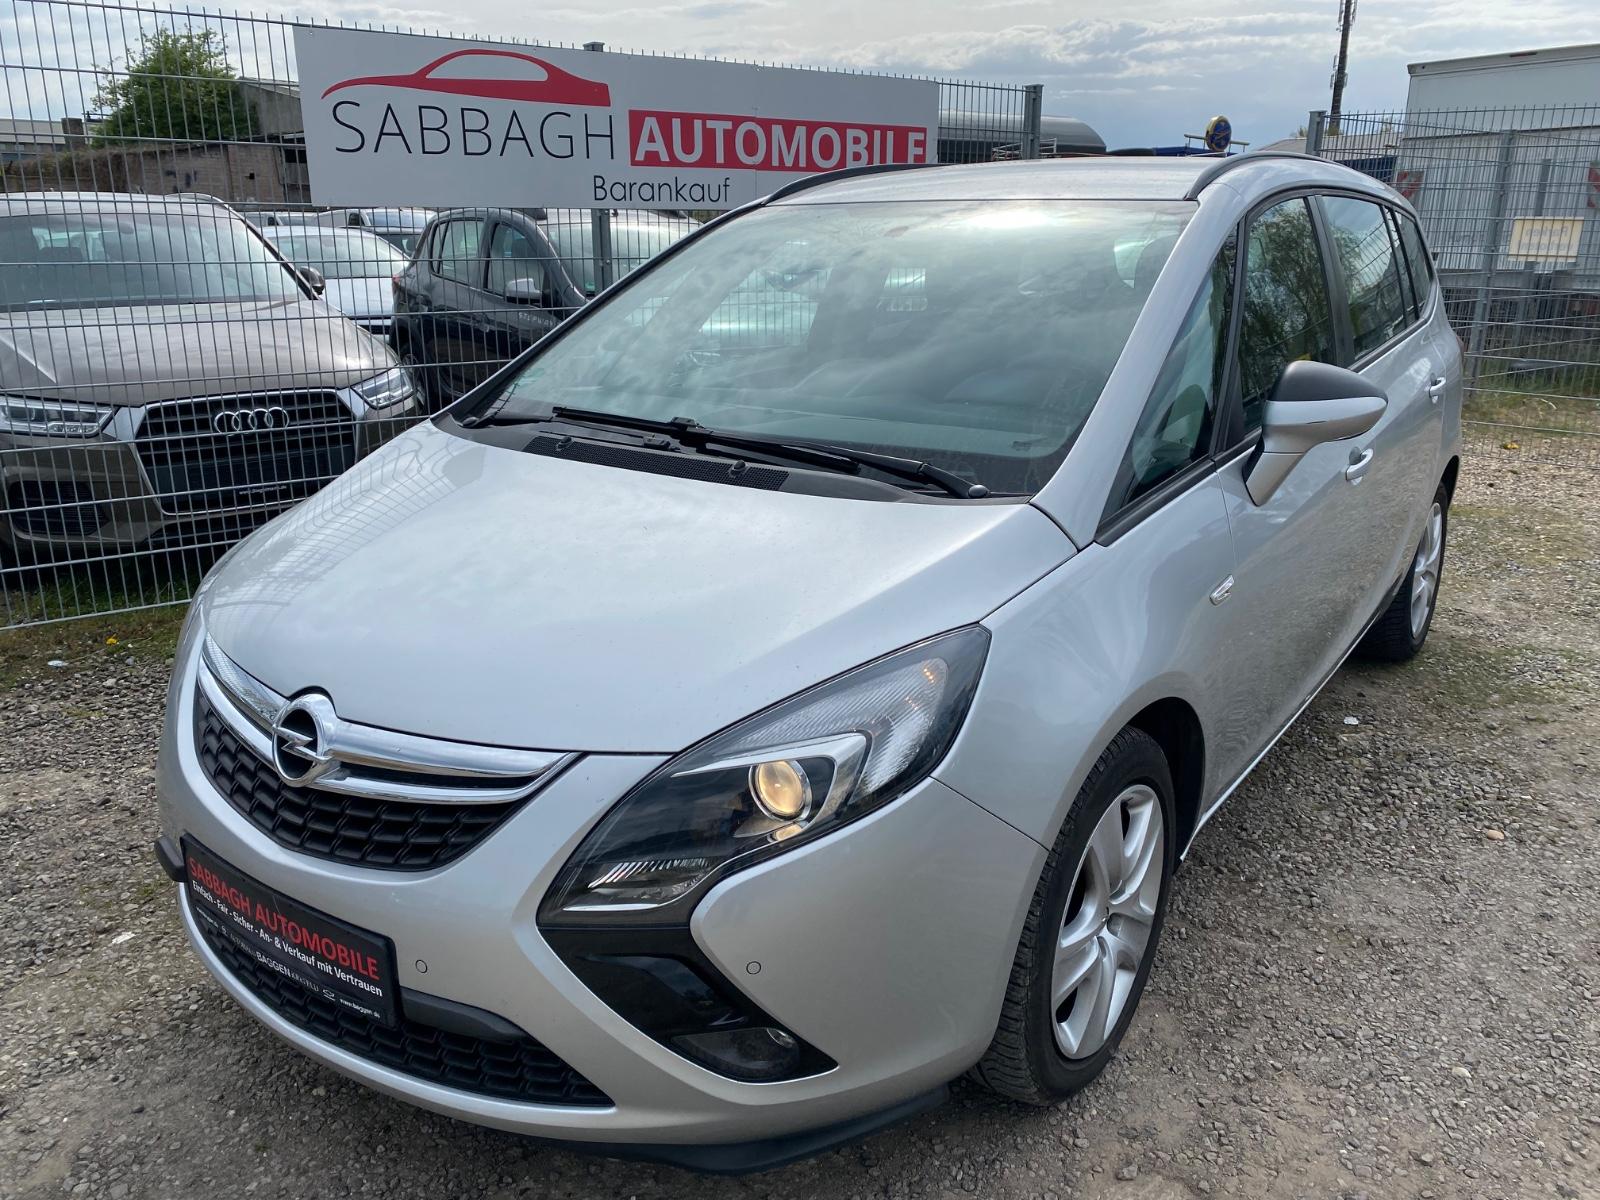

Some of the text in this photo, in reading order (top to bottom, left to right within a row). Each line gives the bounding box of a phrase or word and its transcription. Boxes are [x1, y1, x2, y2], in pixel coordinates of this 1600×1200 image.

[331, 101, 926, 170] SABBAGH AUTOMOBILE
[593, 174, 731, 203] Barankauf
[189, 857, 380, 981] SABBAGH AUTOMOBILE
[192, 879, 214, 904] Einfach
[216, 899, 229, 916] Fair
[233, 911, 254, 933] Sicher
[274, 937, 282, 950] &
[282, 940, 316, 967] Verkauf
[317, 960, 333, 975] mit
[333, 966, 383, 997] Vertrauen
